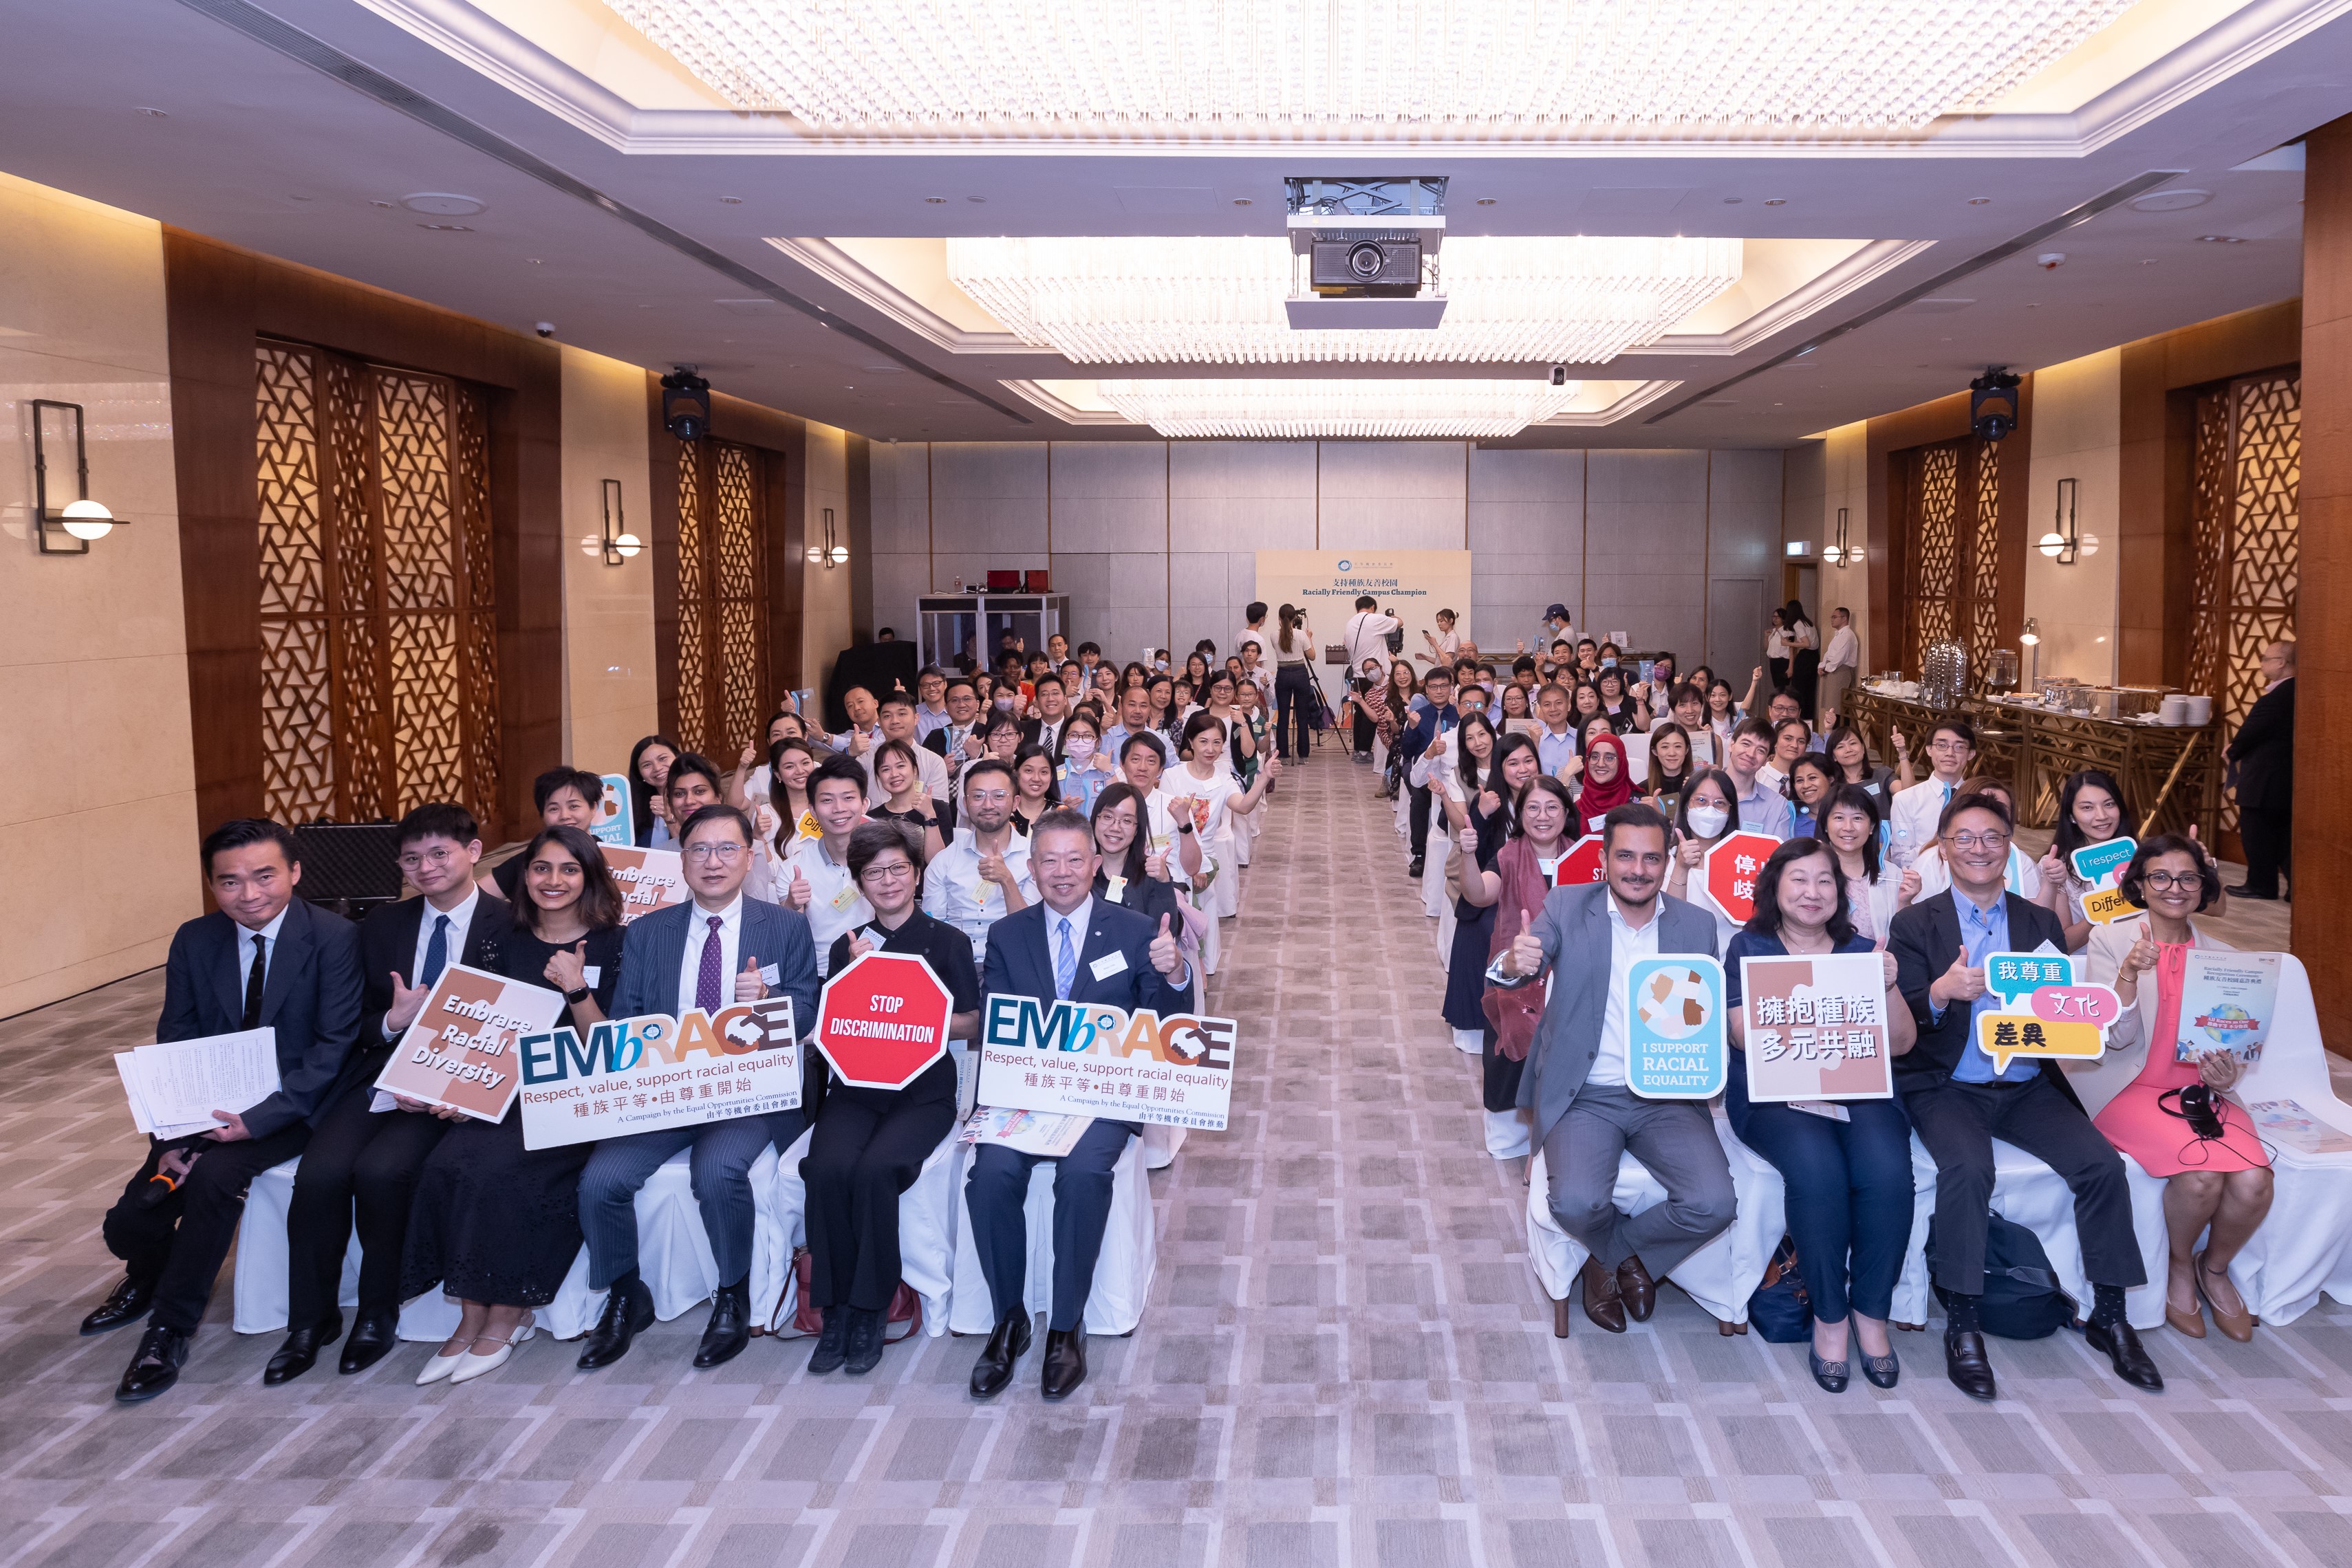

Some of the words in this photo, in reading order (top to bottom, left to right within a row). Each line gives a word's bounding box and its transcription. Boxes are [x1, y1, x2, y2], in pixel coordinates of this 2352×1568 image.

[1302, 589, 1330, 597] Racially
[1331, 589, 1360, 597] Friendly
[1362, 589, 1390, 597] Campus
[1391, 589, 1427, 597] Champion
[1333, 578, 1398, 587] 支持種族友善校園
[2082, 859, 2086, 868] I
[2089, 848, 2132, 866] respect
[1593, 868, 1608, 881] ST
[621, 891, 659, 906] acial
[1998, 961, 2064, 982] 我尊重
[442, 994, 532, 1033] Embrace
[869, 994, 904, 1014] STOP
[1756, 994, 1876, 1026] 擁抱種族
[2049, 992, 2100, 1017] 文化
[441, 1023, 508, 1057] Racial
[830, 1017, 935, 1044] DISCRIMINATION
[987, 997, 1233, 1070] EMbRACE
[1994, 1021, 2047, 1047] 差異
[519, 1001, 793, 1085] EMbRACE
[1642, 1043, 1648, 1053] I
[1650, 1043, 1709, 1054] SUPPORT
[1760, 1029, 1878, 1063] 多元共融
[411, 1045, 506, 1090] Diversity
[984, 1050, 1037, 1068] Respect,
[1042, 1057, 1079, 1073] value,
[1083, 1062, 1134, 1077] support
[1137, 1068, 1172, 1082] racial
[1176, 1074, 1229, 1090] equality
[1643, 1056, 1709, 1071] RACIAL
[524, 1086, 584, 1104] Respect,
[589, 1080, 632, 1094] value,
[636, 1069, 692, 1089] support
[696, 1061, 733, 1078] racial
[738, 1054, 795, 1071] equality
[1643, 1075, 1709, 1087] EQUALITY
[625, 1111, 662, 1124] Campaign
[663, 1109, 672, 1118] by
[673, 1107, 684, 1115] the
[686, 1104, 706, 1113] Equal
[706, 1096, 755, 1111] Opportunities
[755, 1090, 797, 1102] Commission
[706, 1098, 798, 1120] 由平等機會委員會推動
[1068, 1096, 1099, 1105] Campaign
[1101, 1098, 1109, 1107] by
[1122, 1102, 1140, 1110] Equal
[1141, 1104, 1185, 1115] Opportunities
[1186, 1109, 1225, 1119] Commission
[1139, 1112, 1224, 1129] 由平等機會委員會推動
